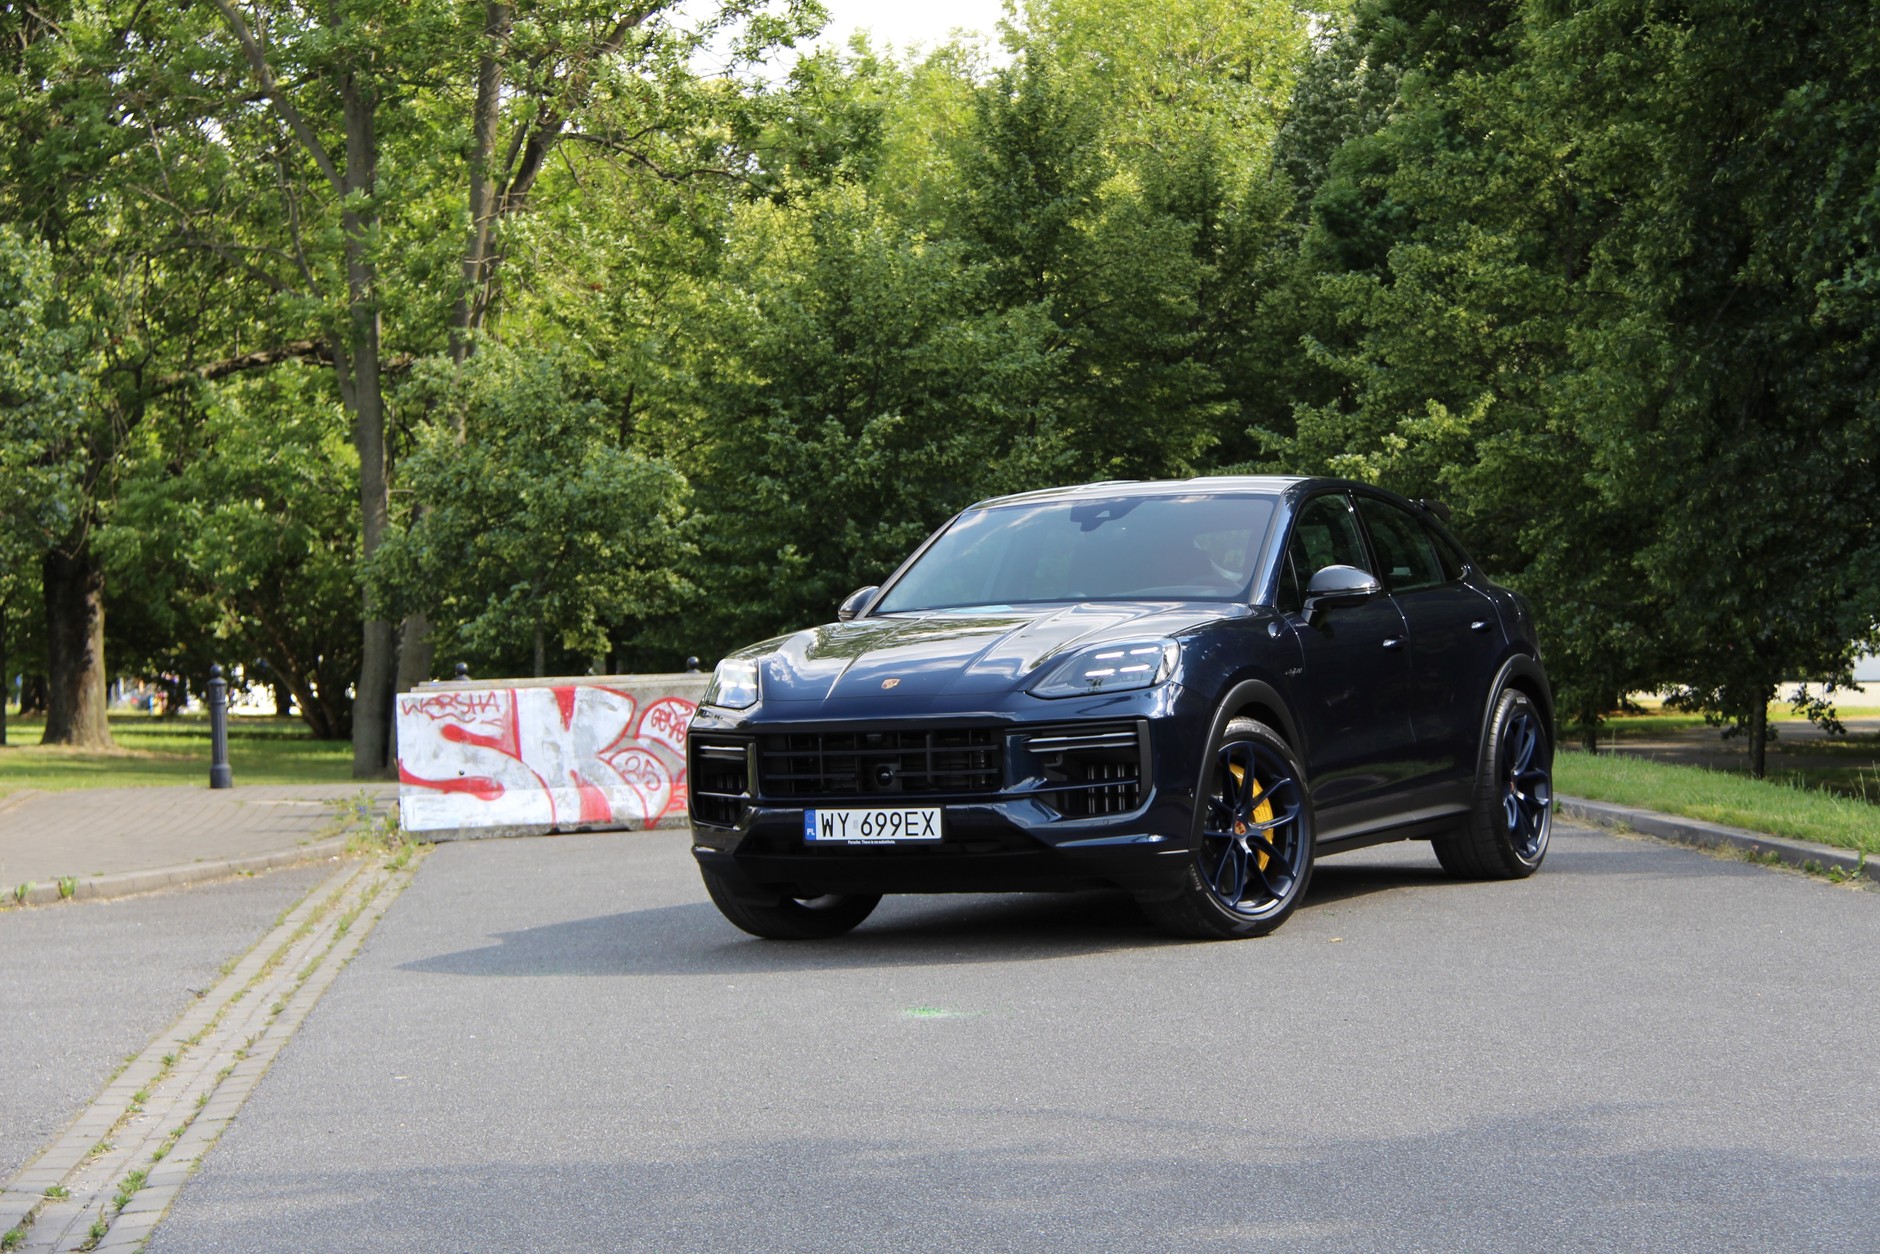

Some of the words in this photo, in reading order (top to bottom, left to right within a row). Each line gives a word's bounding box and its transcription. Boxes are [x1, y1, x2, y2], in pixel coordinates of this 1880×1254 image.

[806, 828, 816, 836] PL
[821, 812, 850, 838] WY
[861, 811, 935, 836] 699EX
